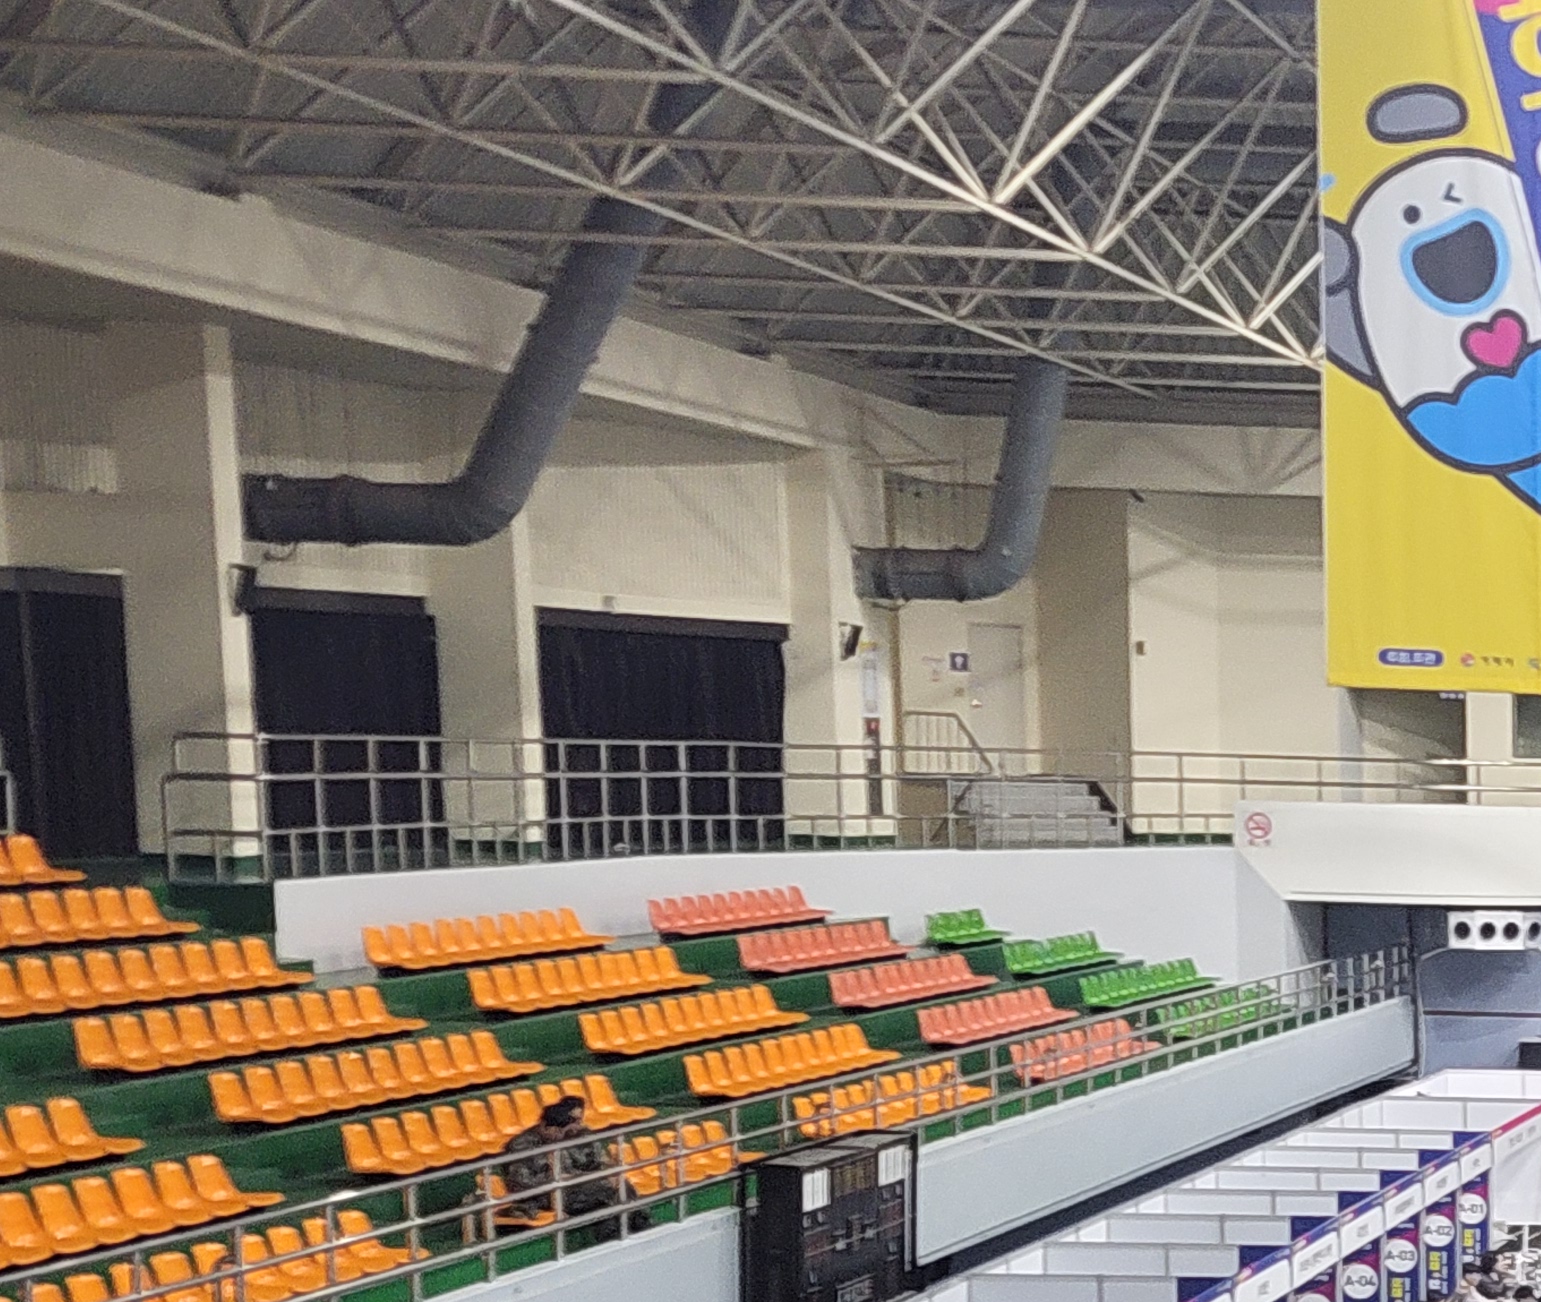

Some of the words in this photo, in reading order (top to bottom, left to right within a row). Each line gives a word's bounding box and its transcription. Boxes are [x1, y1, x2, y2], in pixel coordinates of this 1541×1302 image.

[1424, 1225, 1453, 1237] A-02
[1386, 1249, 1415, 1262] A-03
[1345, 1275, 1376, 1288] A-04
